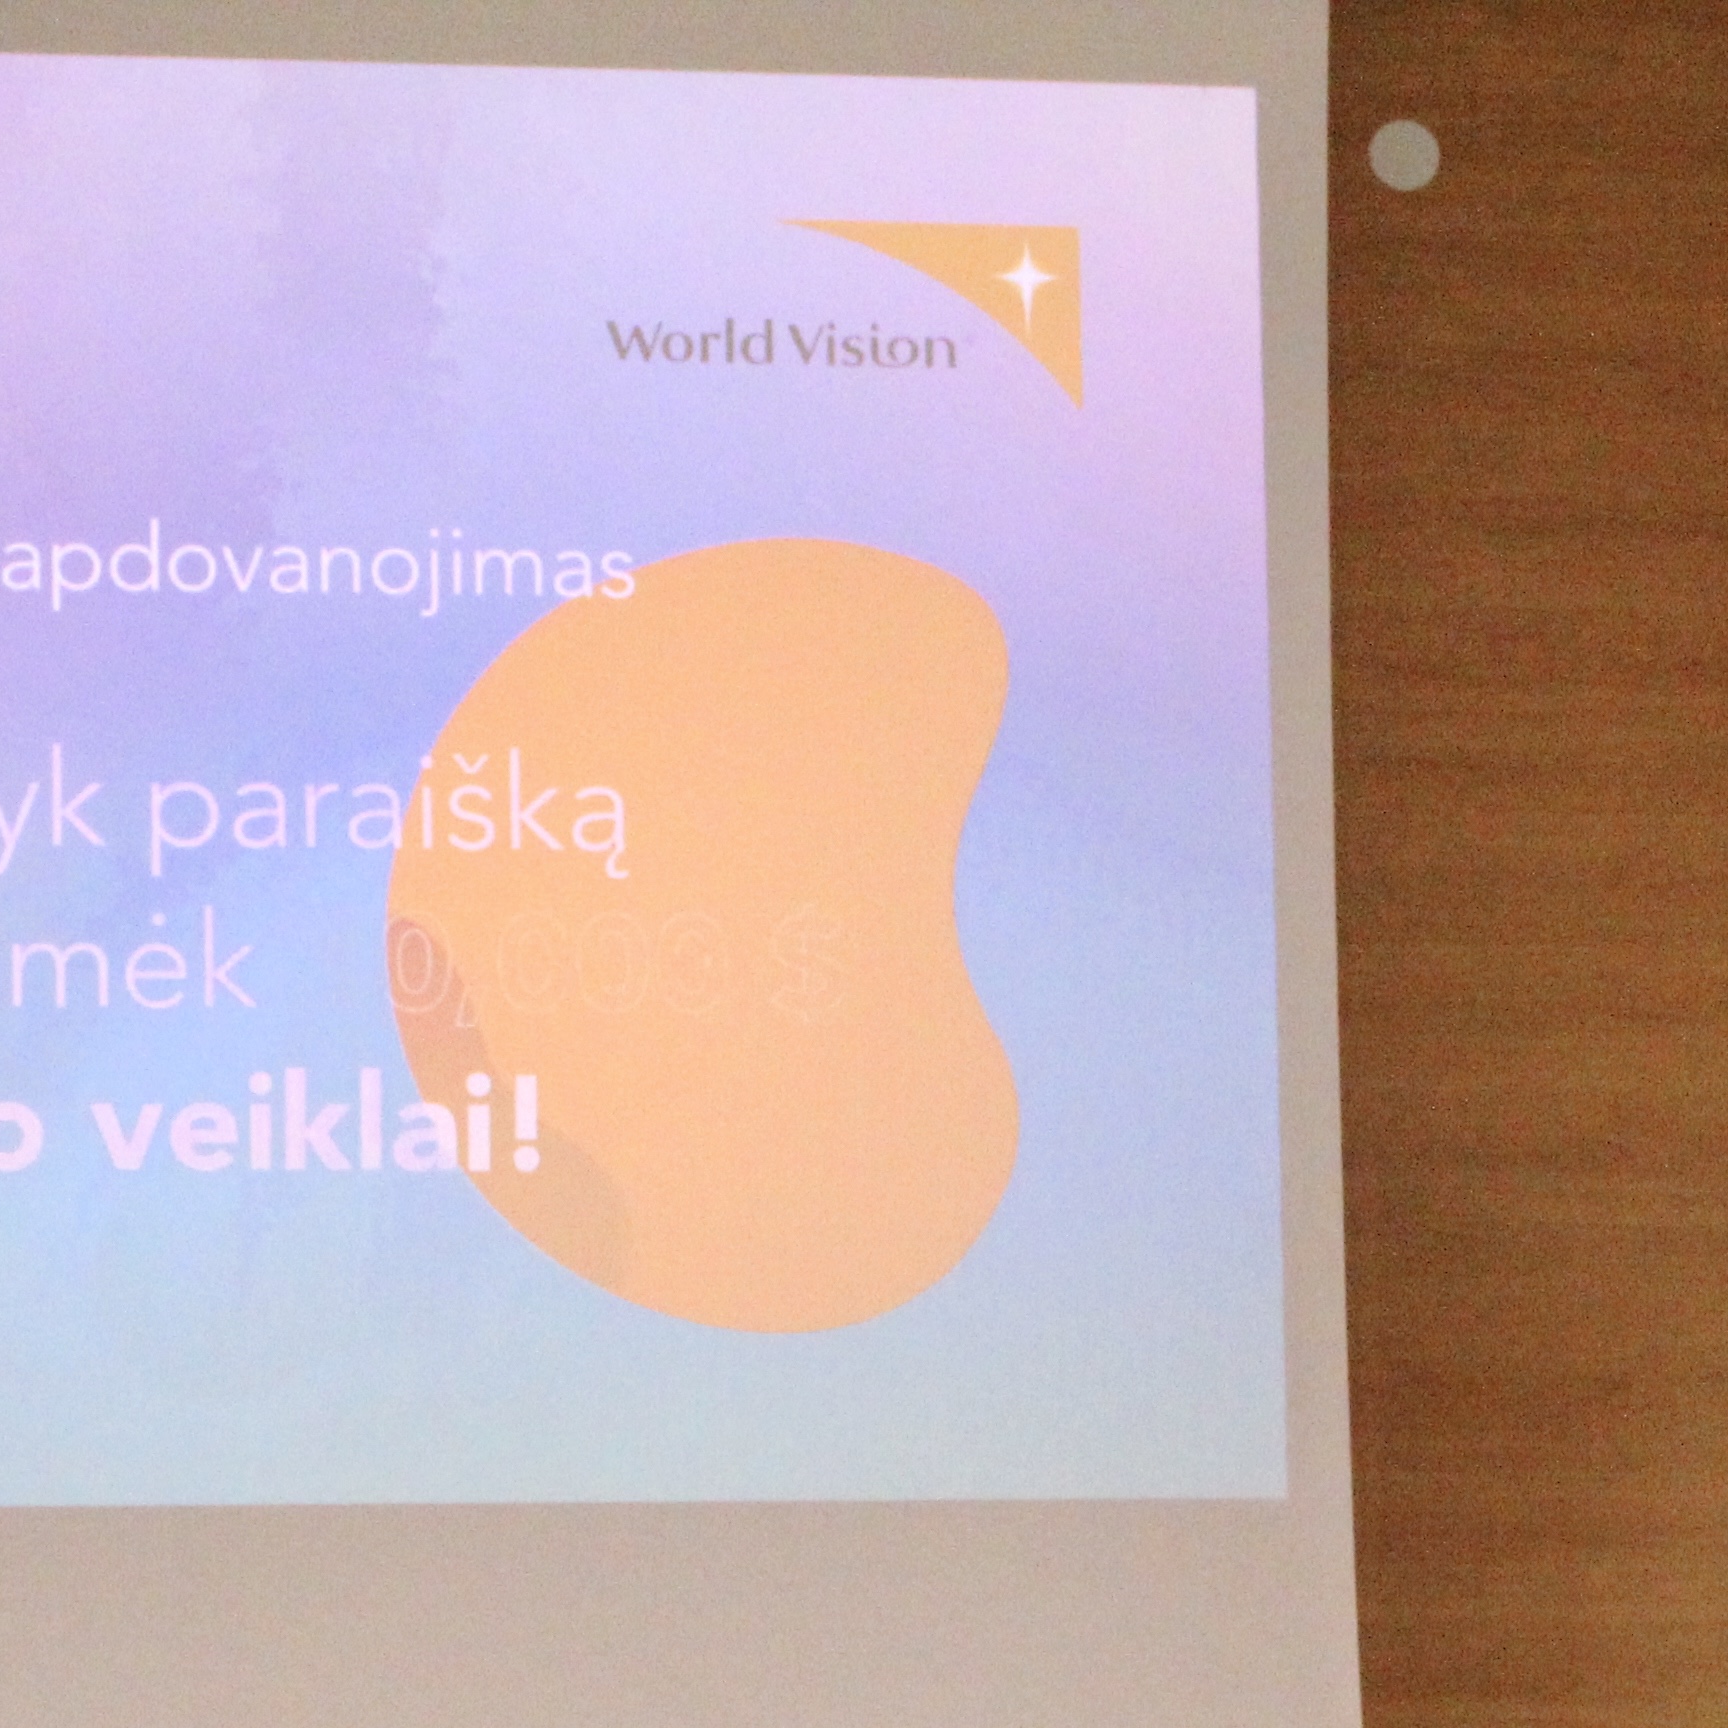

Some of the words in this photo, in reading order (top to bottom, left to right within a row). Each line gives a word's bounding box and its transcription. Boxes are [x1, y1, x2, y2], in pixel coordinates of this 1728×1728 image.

[606, 317, 775, 365] World
[787, 321, 959, 370] Vision
[0, 516, 638, 618] apdovanojimas
[148, 746, 632, 881] paraišką
[94, 1070, 543, 1174] veiklai!
